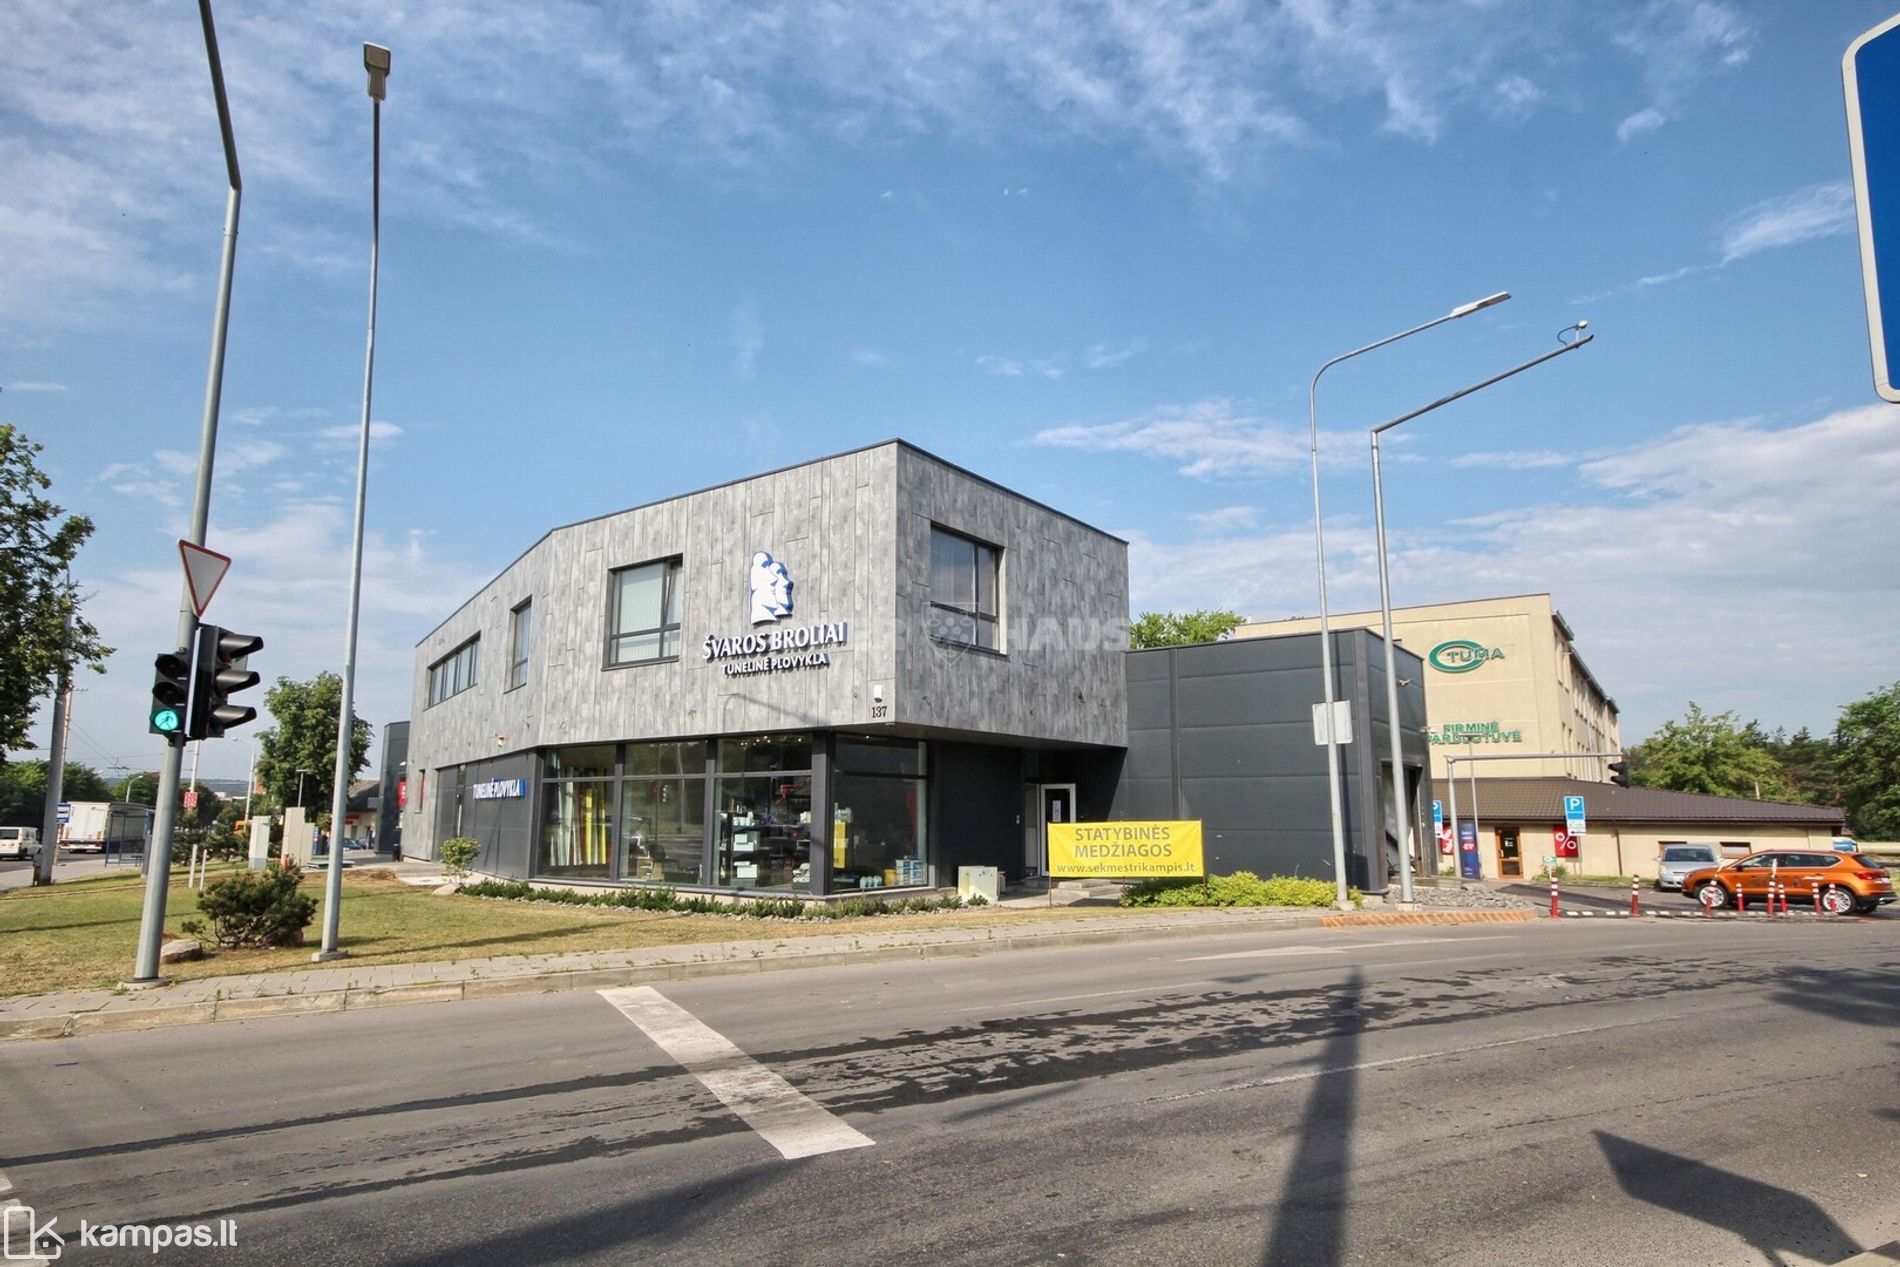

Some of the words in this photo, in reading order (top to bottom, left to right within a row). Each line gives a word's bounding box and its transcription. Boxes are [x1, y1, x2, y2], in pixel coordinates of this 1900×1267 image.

[702, 633, 769, 660] ŠVAROS
[769, 621, 846, 650] BROLIAI
[1446, 646, 1505, 663] TUMA
[721, 656, 769, 675] TUNELINĖ
[771, 652, 831, 670] PLOVYKLA
[872, 706, 888, 718] 137
[1570, 798, 1581, 811] P
[1074, 824, 1171, 842] STATYBINĖS
[1074, 842, 1172, 858] MEDŽIAGOS
[1057, 862, 1195, 874] www.sekmestrikampis.lt
